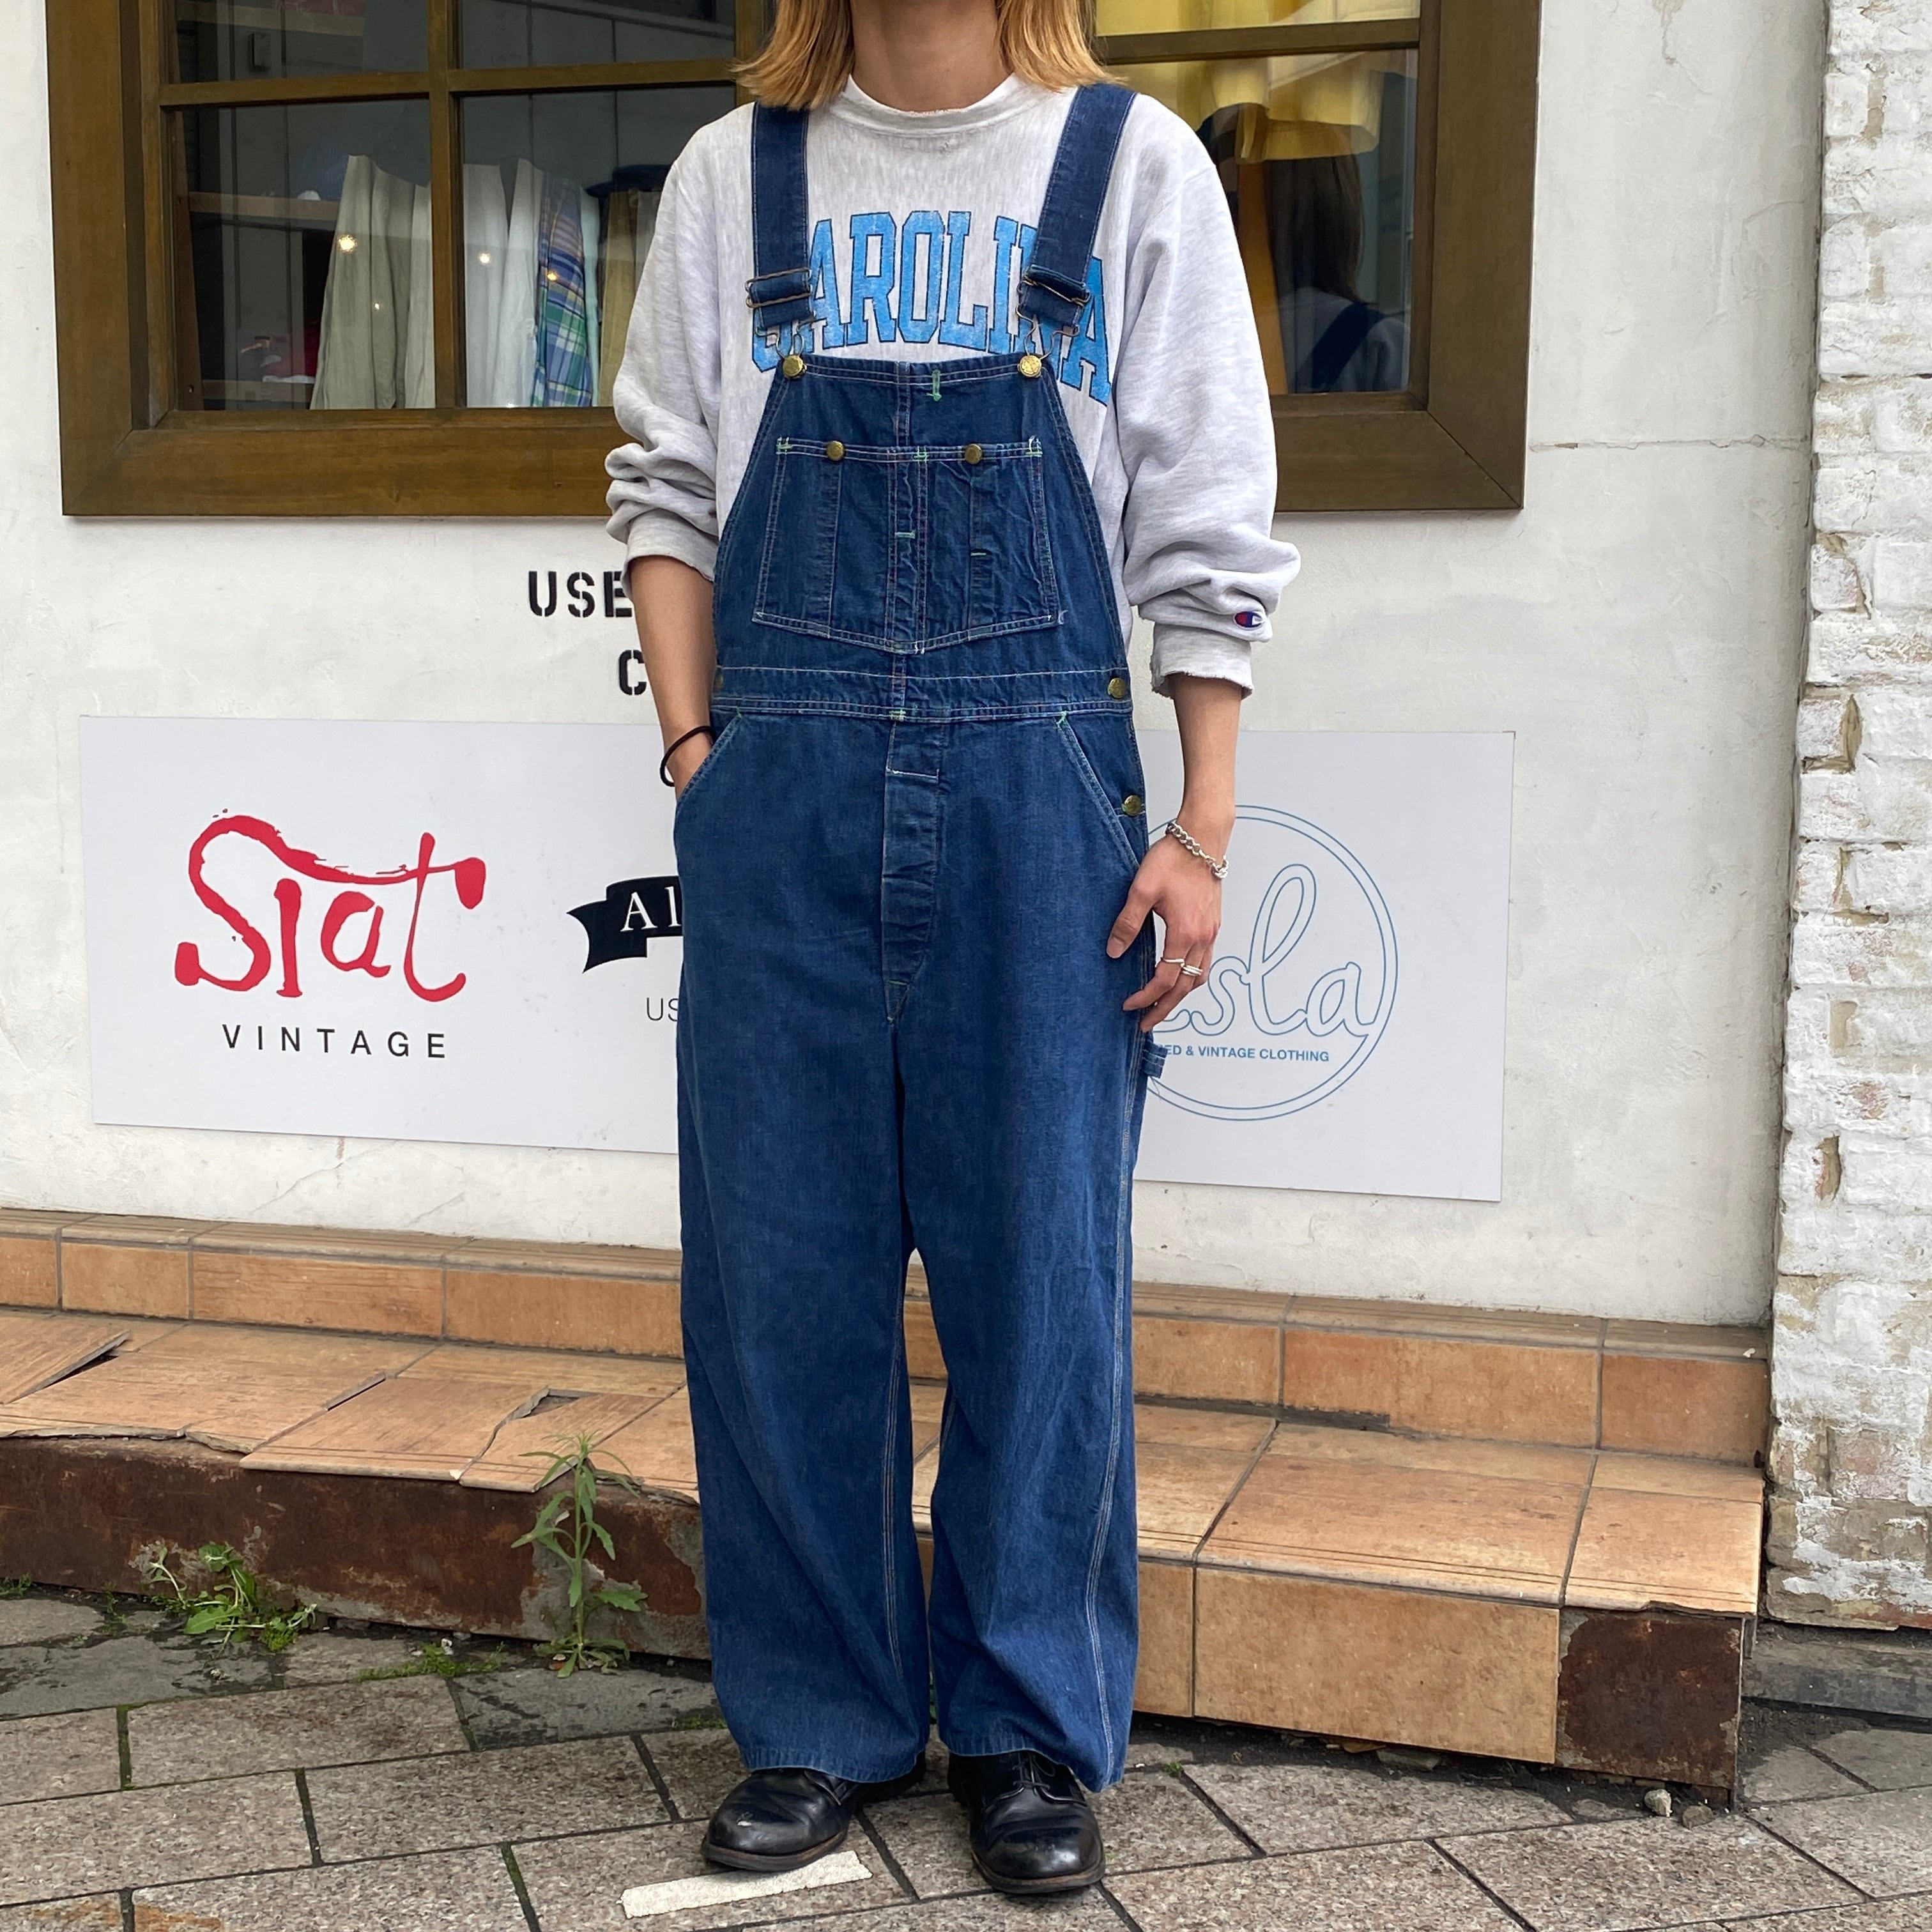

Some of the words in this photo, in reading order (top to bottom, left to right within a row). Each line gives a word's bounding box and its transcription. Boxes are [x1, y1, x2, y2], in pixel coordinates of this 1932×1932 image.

[1153, 864, 1374, 1036] sla
[222, 1024, 445, 1058] VINTAGE
[1158, 1044, 1182, 1055] ED
[1186, 1045, 1194, 1056] &
[1198, 1046, 1255, 1059] VINTAGE
[1259, 1048, 1330, 1062] CLOTHING
